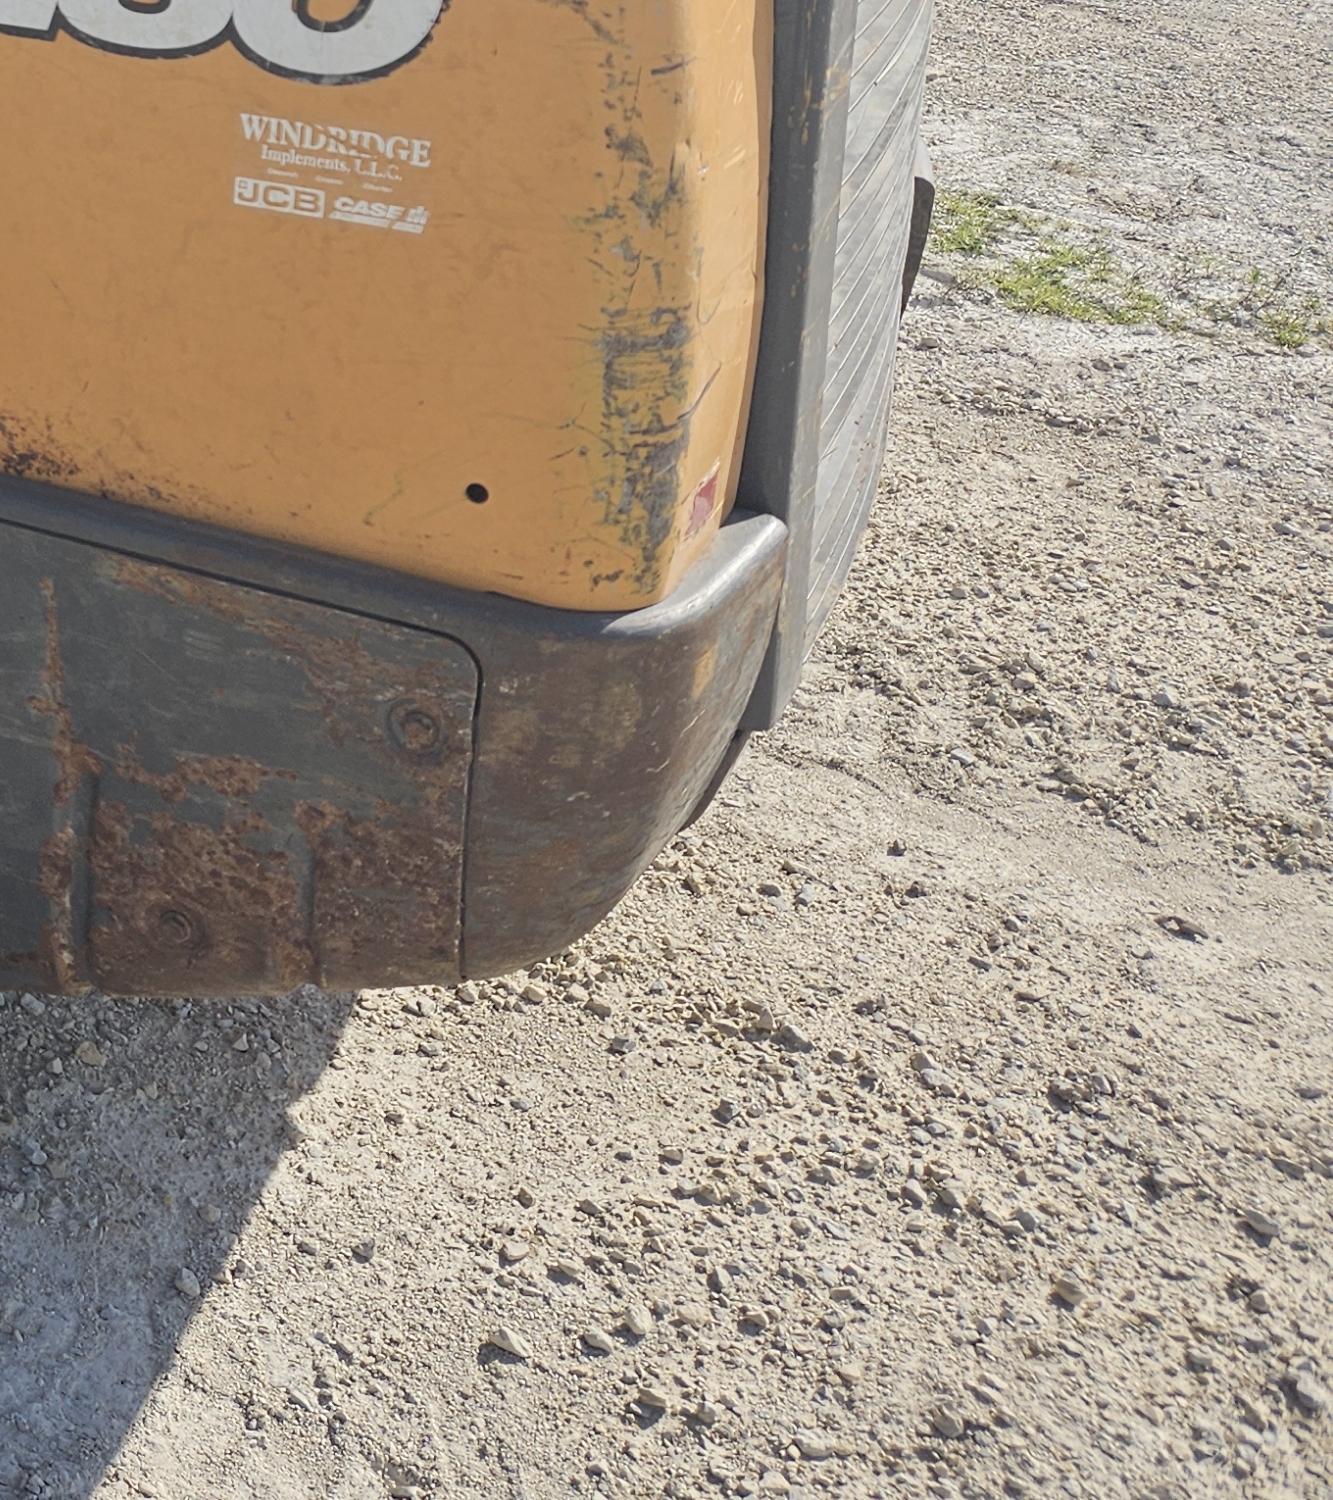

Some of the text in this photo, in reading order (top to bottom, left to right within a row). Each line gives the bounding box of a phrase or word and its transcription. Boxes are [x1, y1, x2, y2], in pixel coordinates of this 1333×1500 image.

[239, 112, 431, 168] WINDRIDGE
[236, 179, 406, 220] JCB CASE
